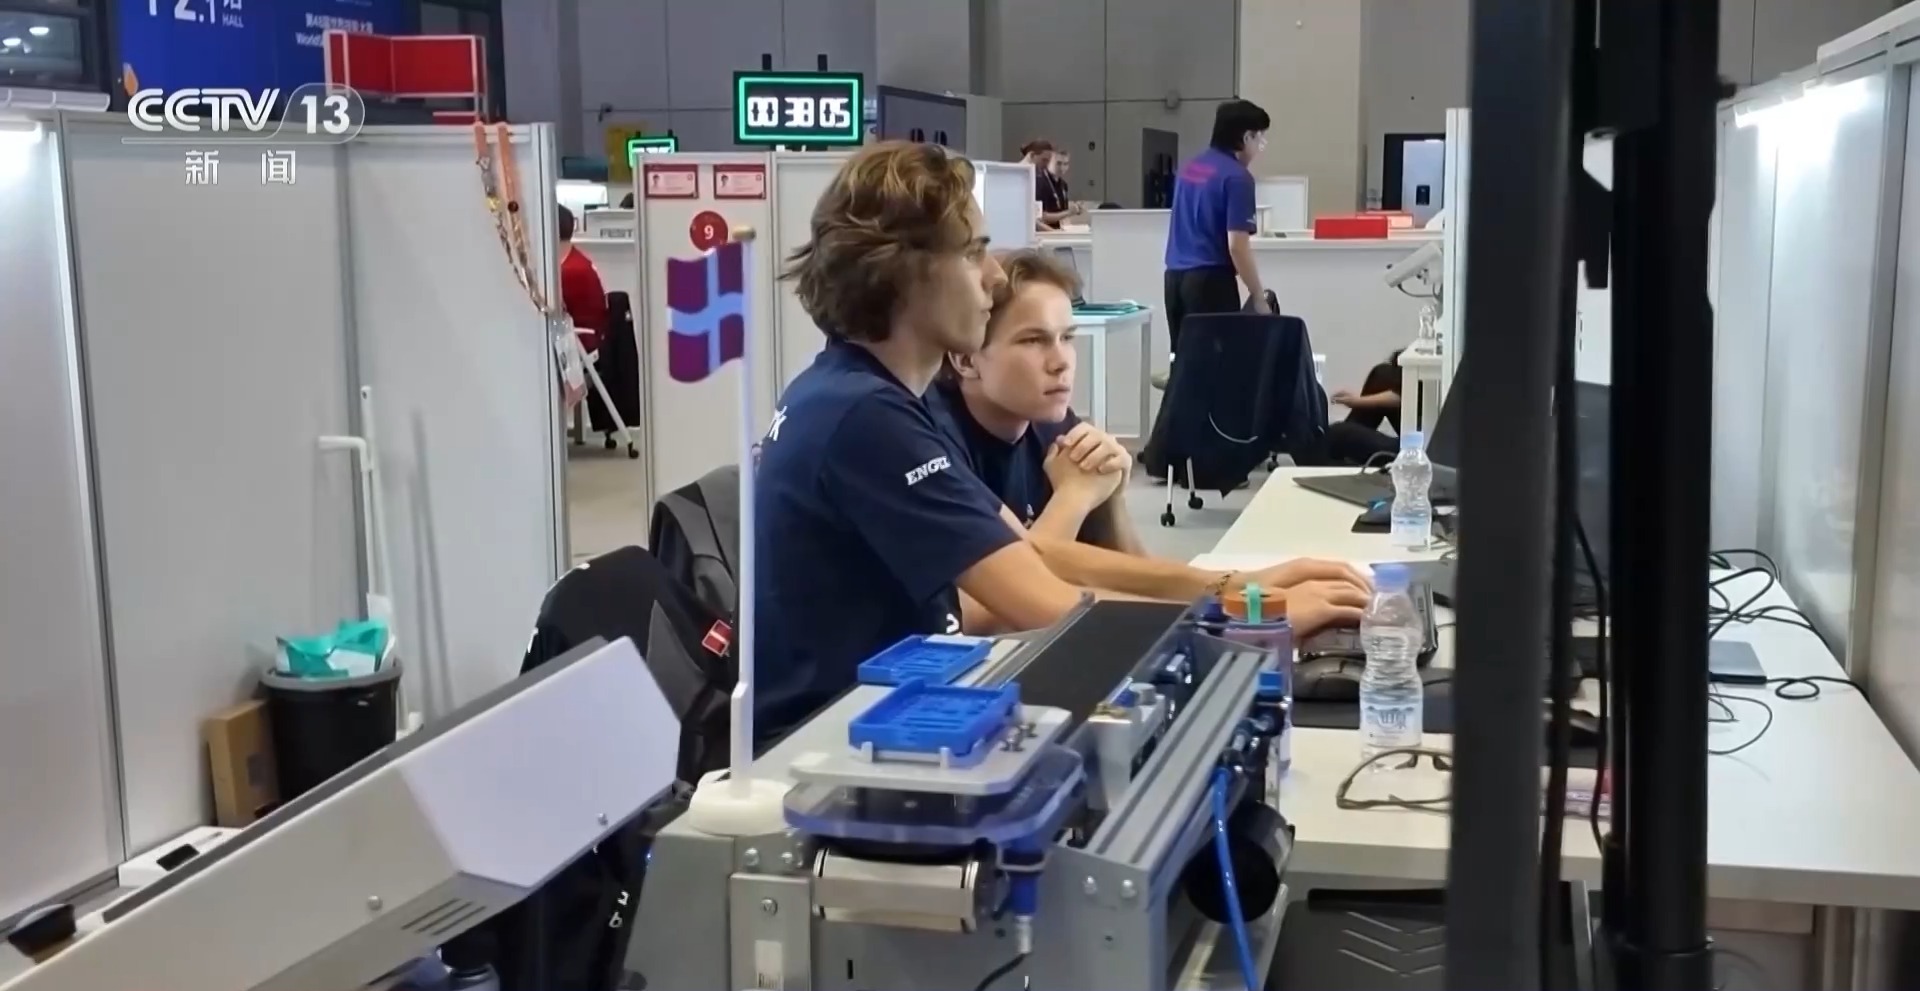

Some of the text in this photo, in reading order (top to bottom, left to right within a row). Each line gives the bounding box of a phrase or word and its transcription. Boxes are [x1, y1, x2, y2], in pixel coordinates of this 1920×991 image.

[747, 96, 851, 128] 00 38 05
[703, 224, 714, 240] 9
